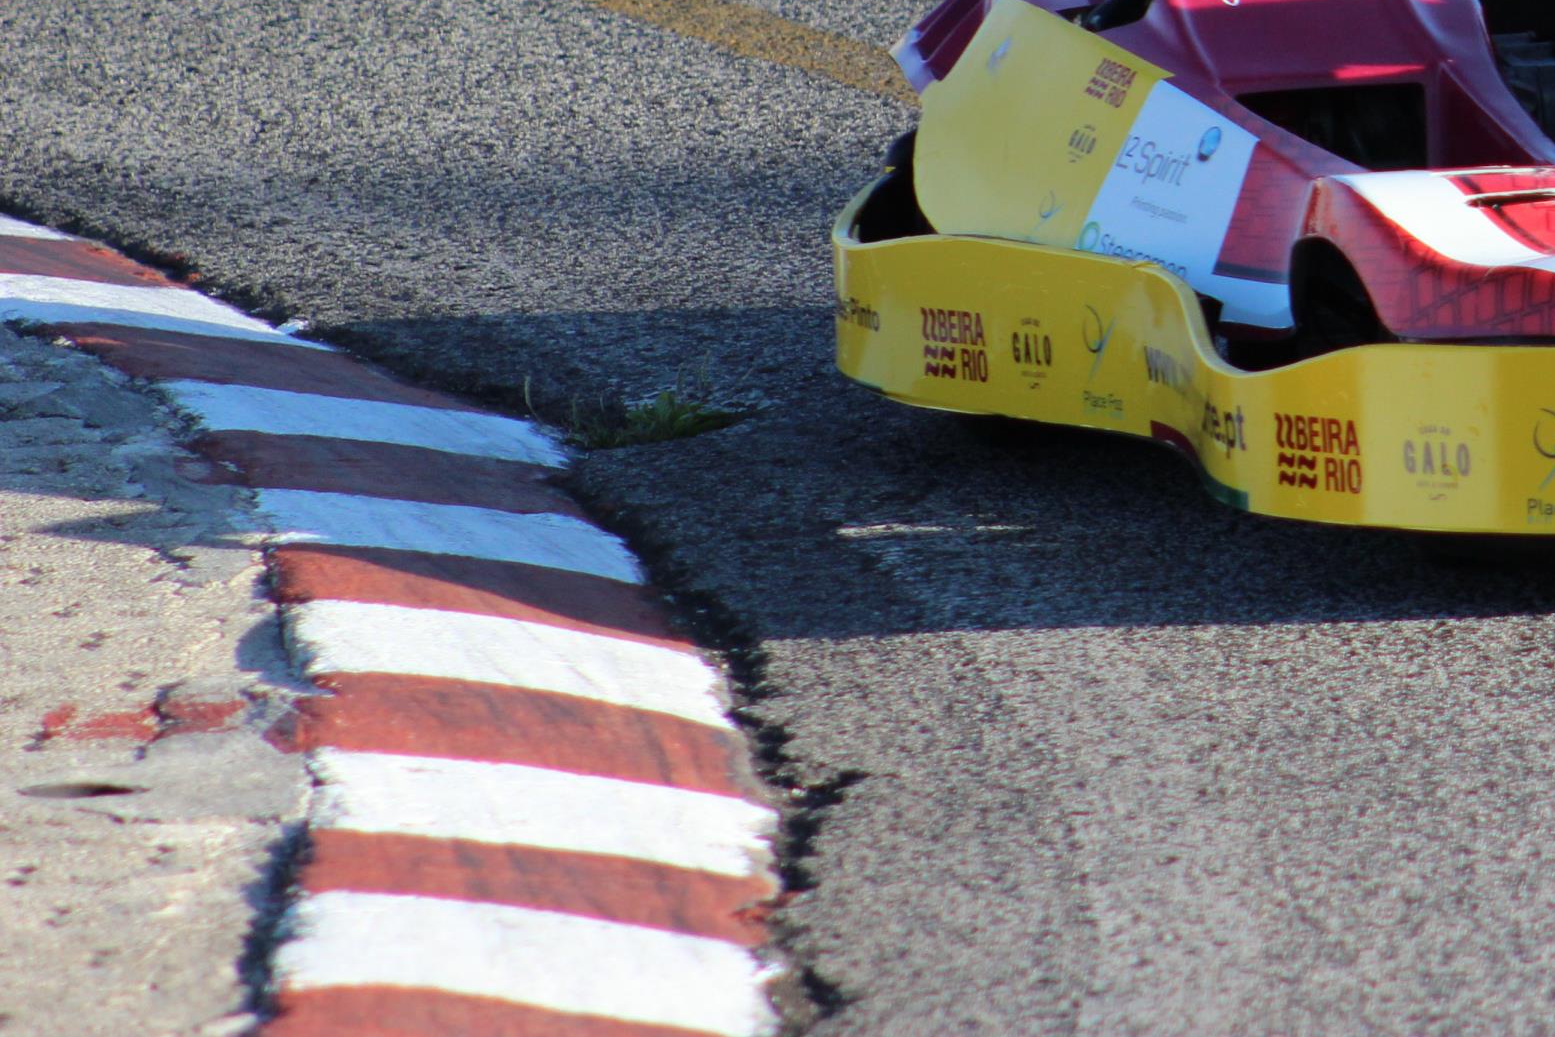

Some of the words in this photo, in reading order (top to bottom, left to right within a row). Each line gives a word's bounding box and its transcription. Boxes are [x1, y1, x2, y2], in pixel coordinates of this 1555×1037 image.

[938, 308, 986, 346] BEIRA
[961, 348, 988, 383] RIO
[1012, 331, 1052, 367] GALO
[1295, 415, 1360, 456] BEIRA
[1324, 457, 1362, 494] RIO
[1403, 439, 1471, 477] GALO
